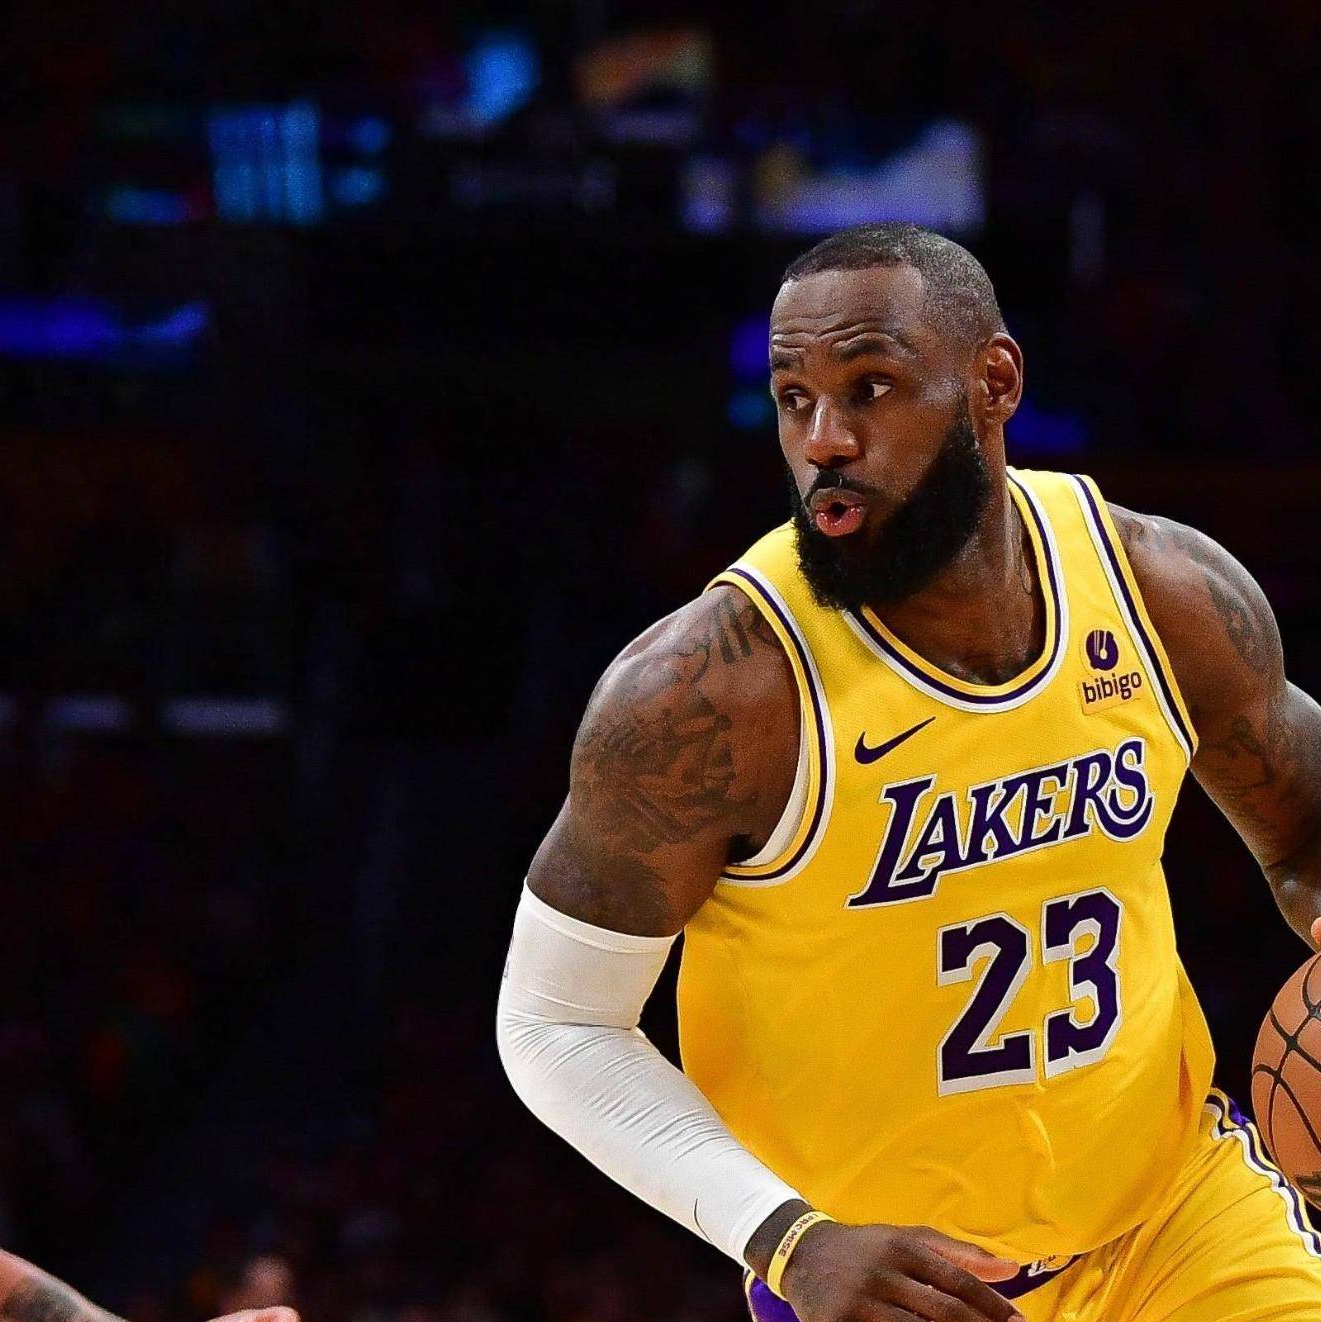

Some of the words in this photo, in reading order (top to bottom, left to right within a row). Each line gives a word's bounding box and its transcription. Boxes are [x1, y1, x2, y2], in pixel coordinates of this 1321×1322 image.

[1081, 671, 1143, 704] bibigo
[843, 736, 1156, 910] LAKERS
[936, 885, 1124, 1097] 23
